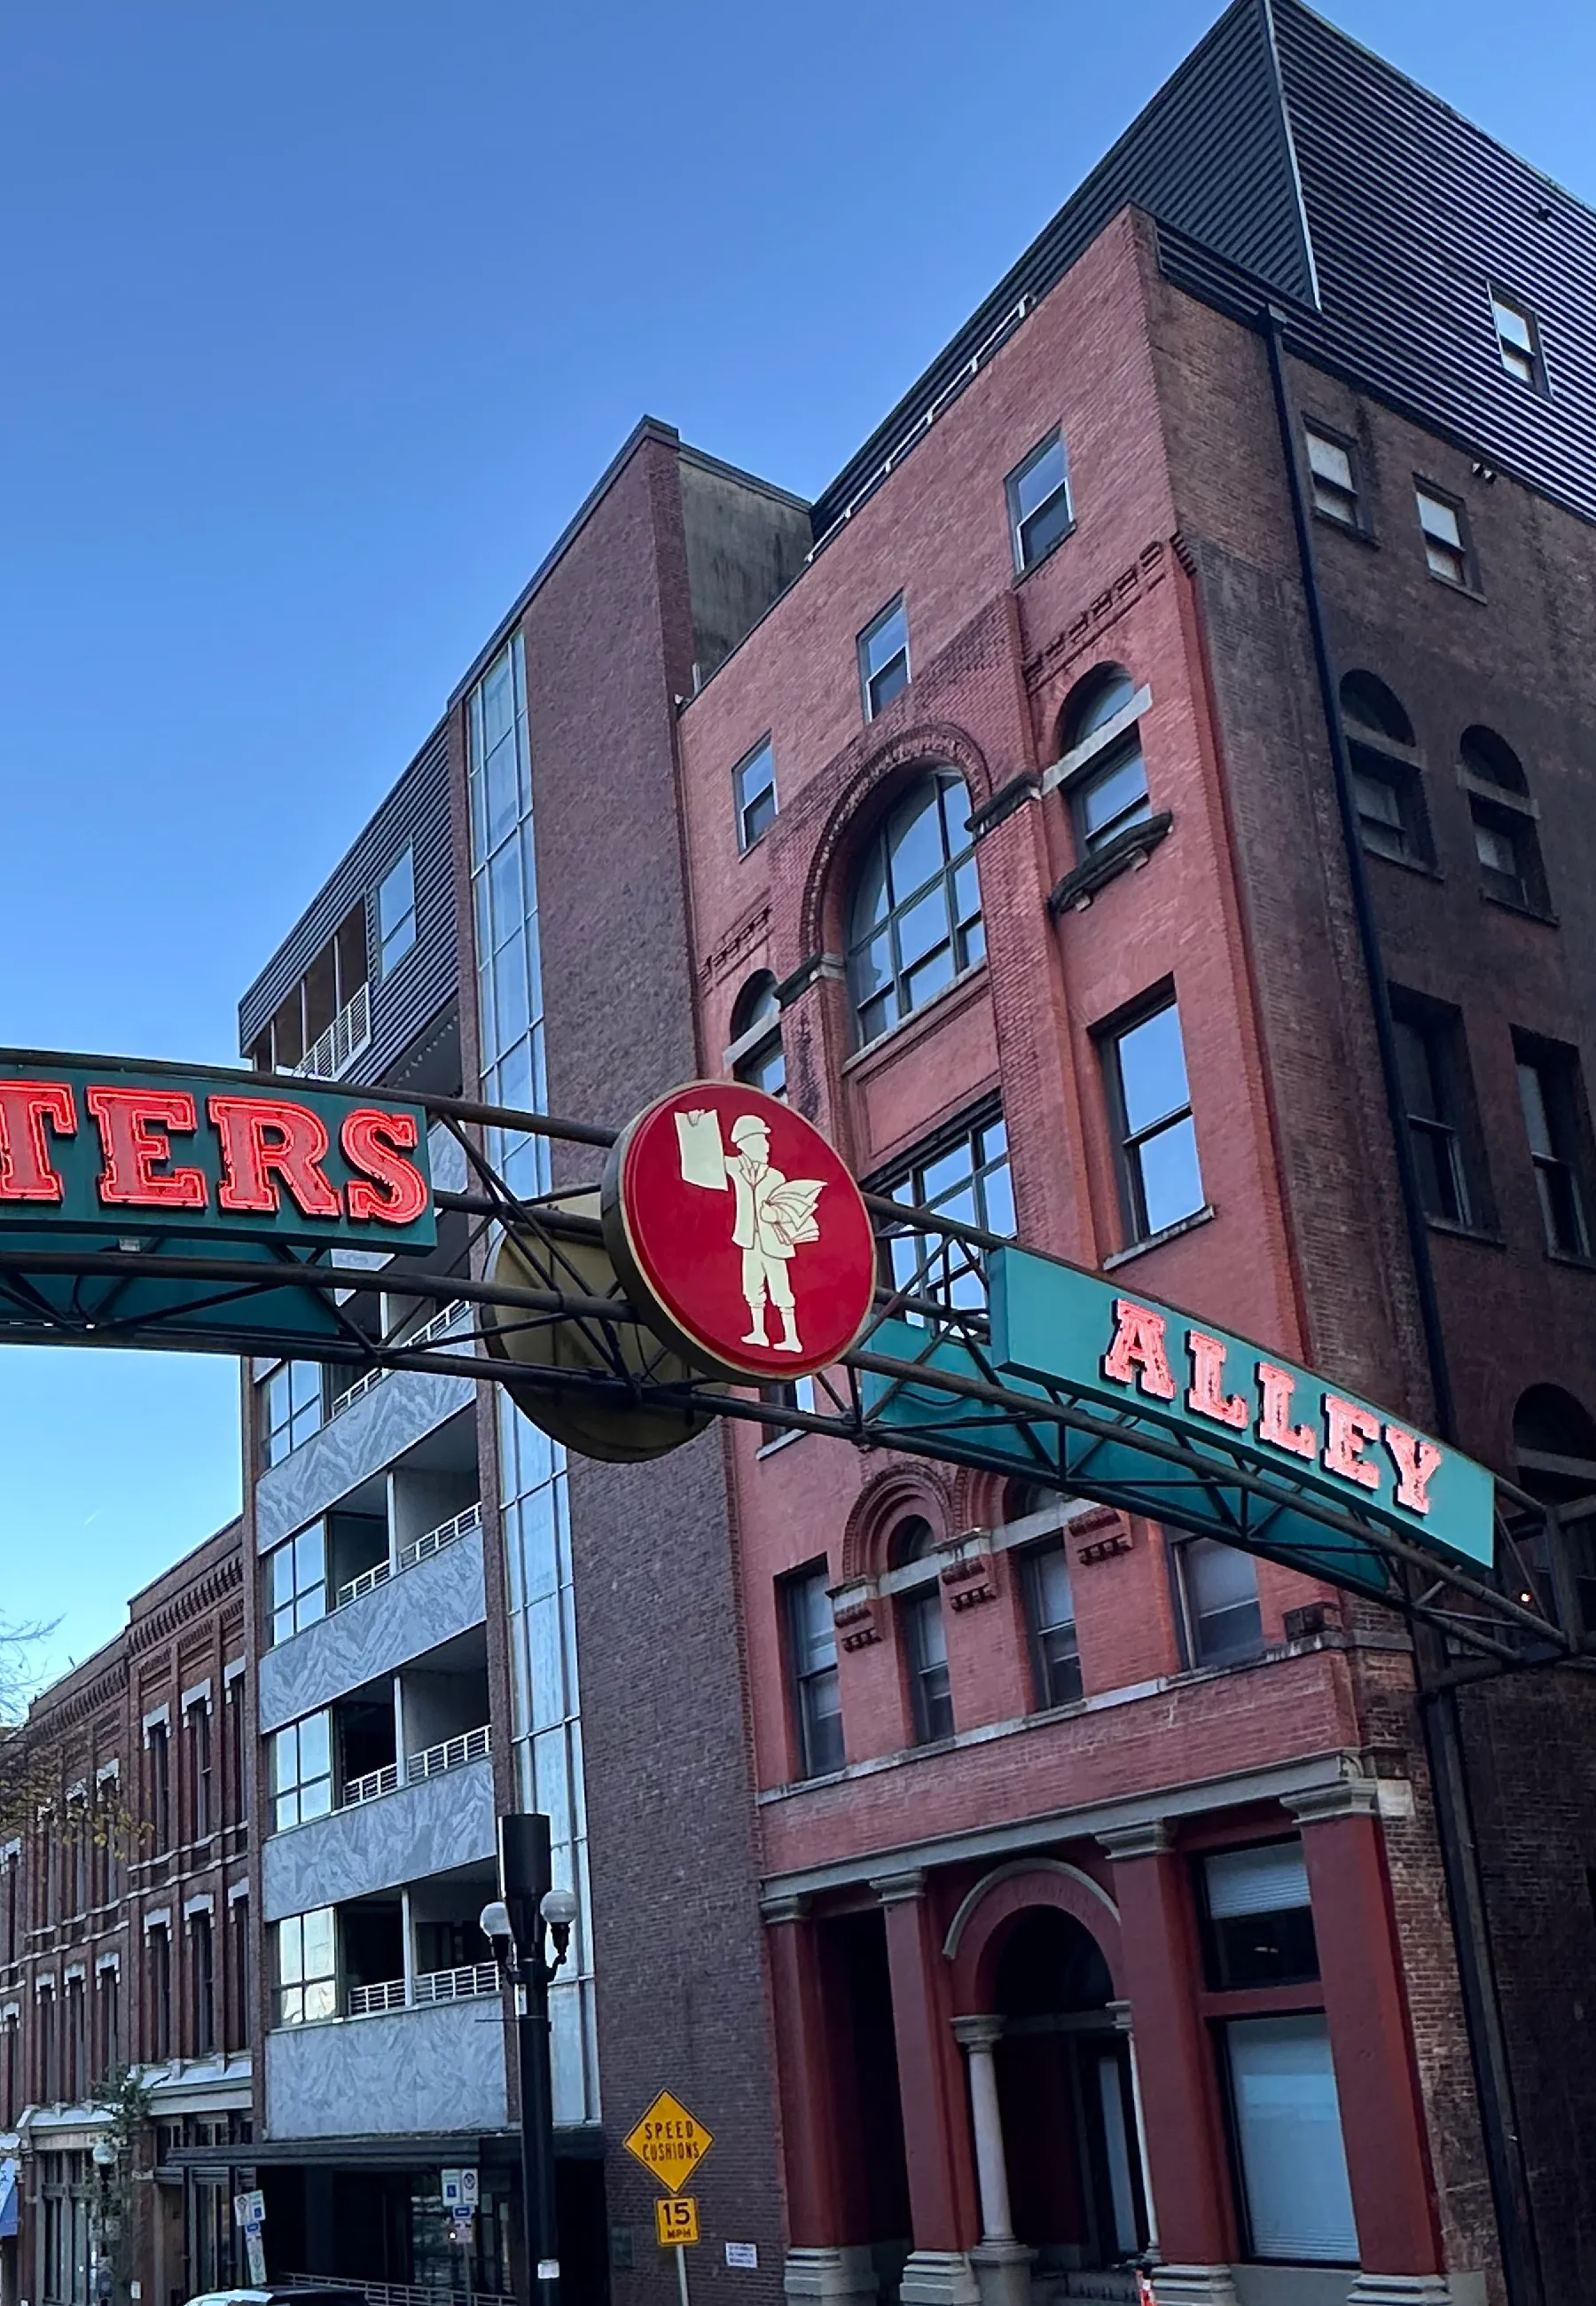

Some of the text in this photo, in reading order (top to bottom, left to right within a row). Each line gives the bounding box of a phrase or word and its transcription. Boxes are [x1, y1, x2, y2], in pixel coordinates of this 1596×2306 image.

[1102, 1298, 1443, 1516] ALLEY
[645, 2120, 693, 2140] SPEED
[643, 2141, 700, 2161] CUSHIONS
[663, 2202, 690, 2225] 15
[667, 2229, 691, 2239] MPH
